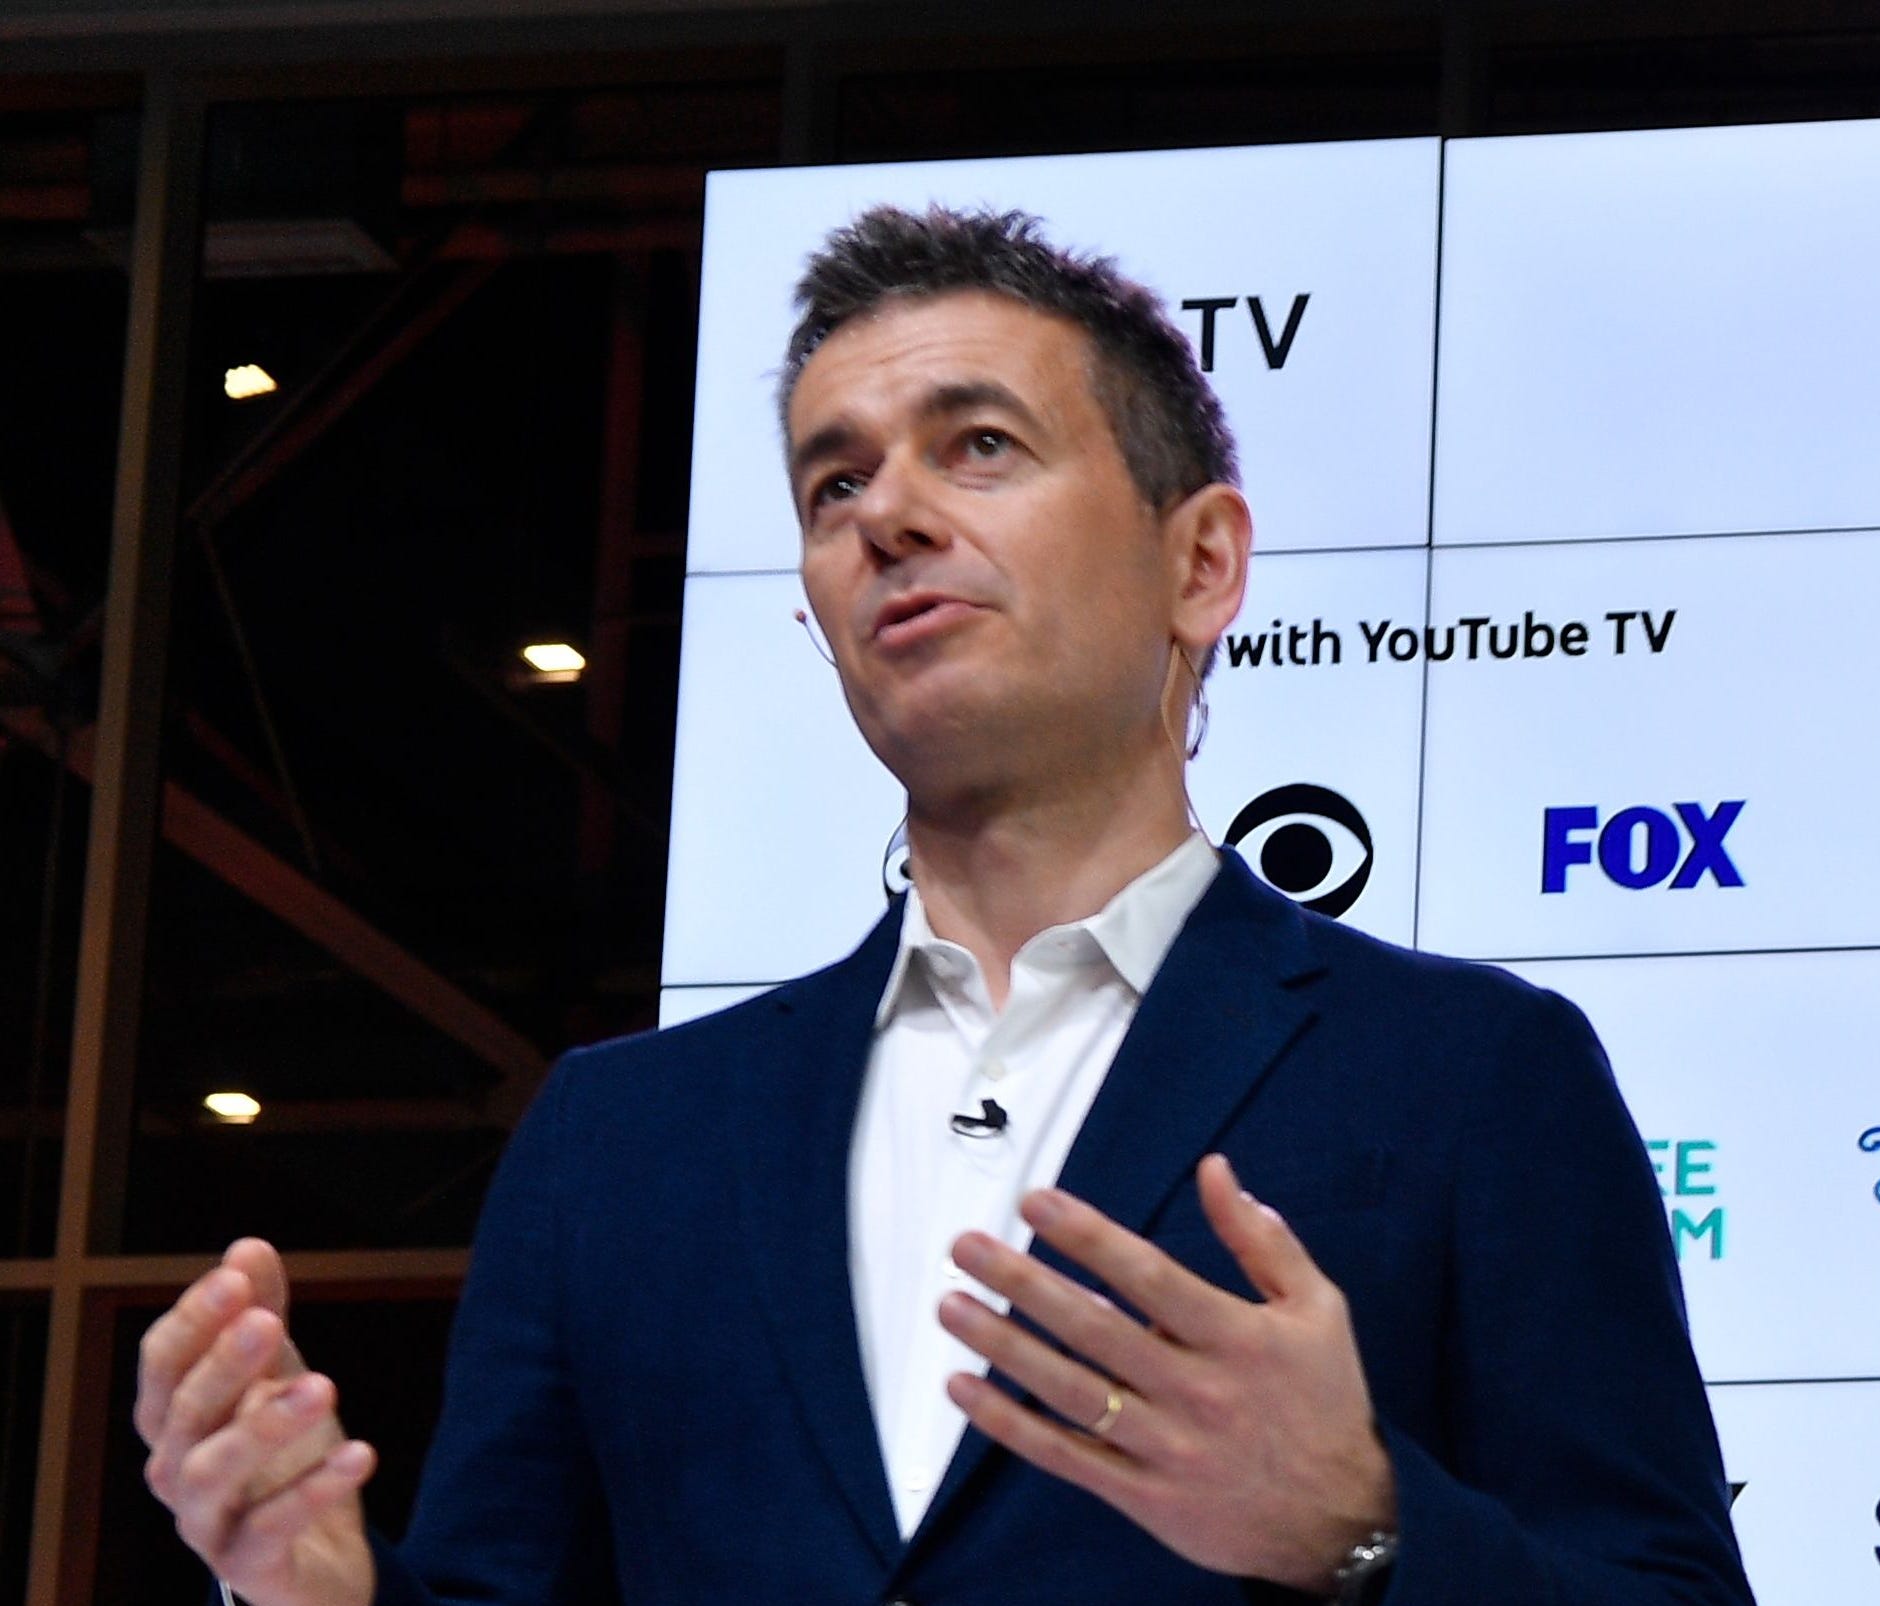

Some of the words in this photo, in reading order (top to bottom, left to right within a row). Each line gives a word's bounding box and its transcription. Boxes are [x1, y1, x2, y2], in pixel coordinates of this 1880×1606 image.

[1181, 293, 1311, 373] TV
[1228, 619, 1342, 668] with
[1357, 610, 1590, 664] YouTube
[1605, 610, 1677, 655] TV
[1541, 800, 1747, 895] FOX
